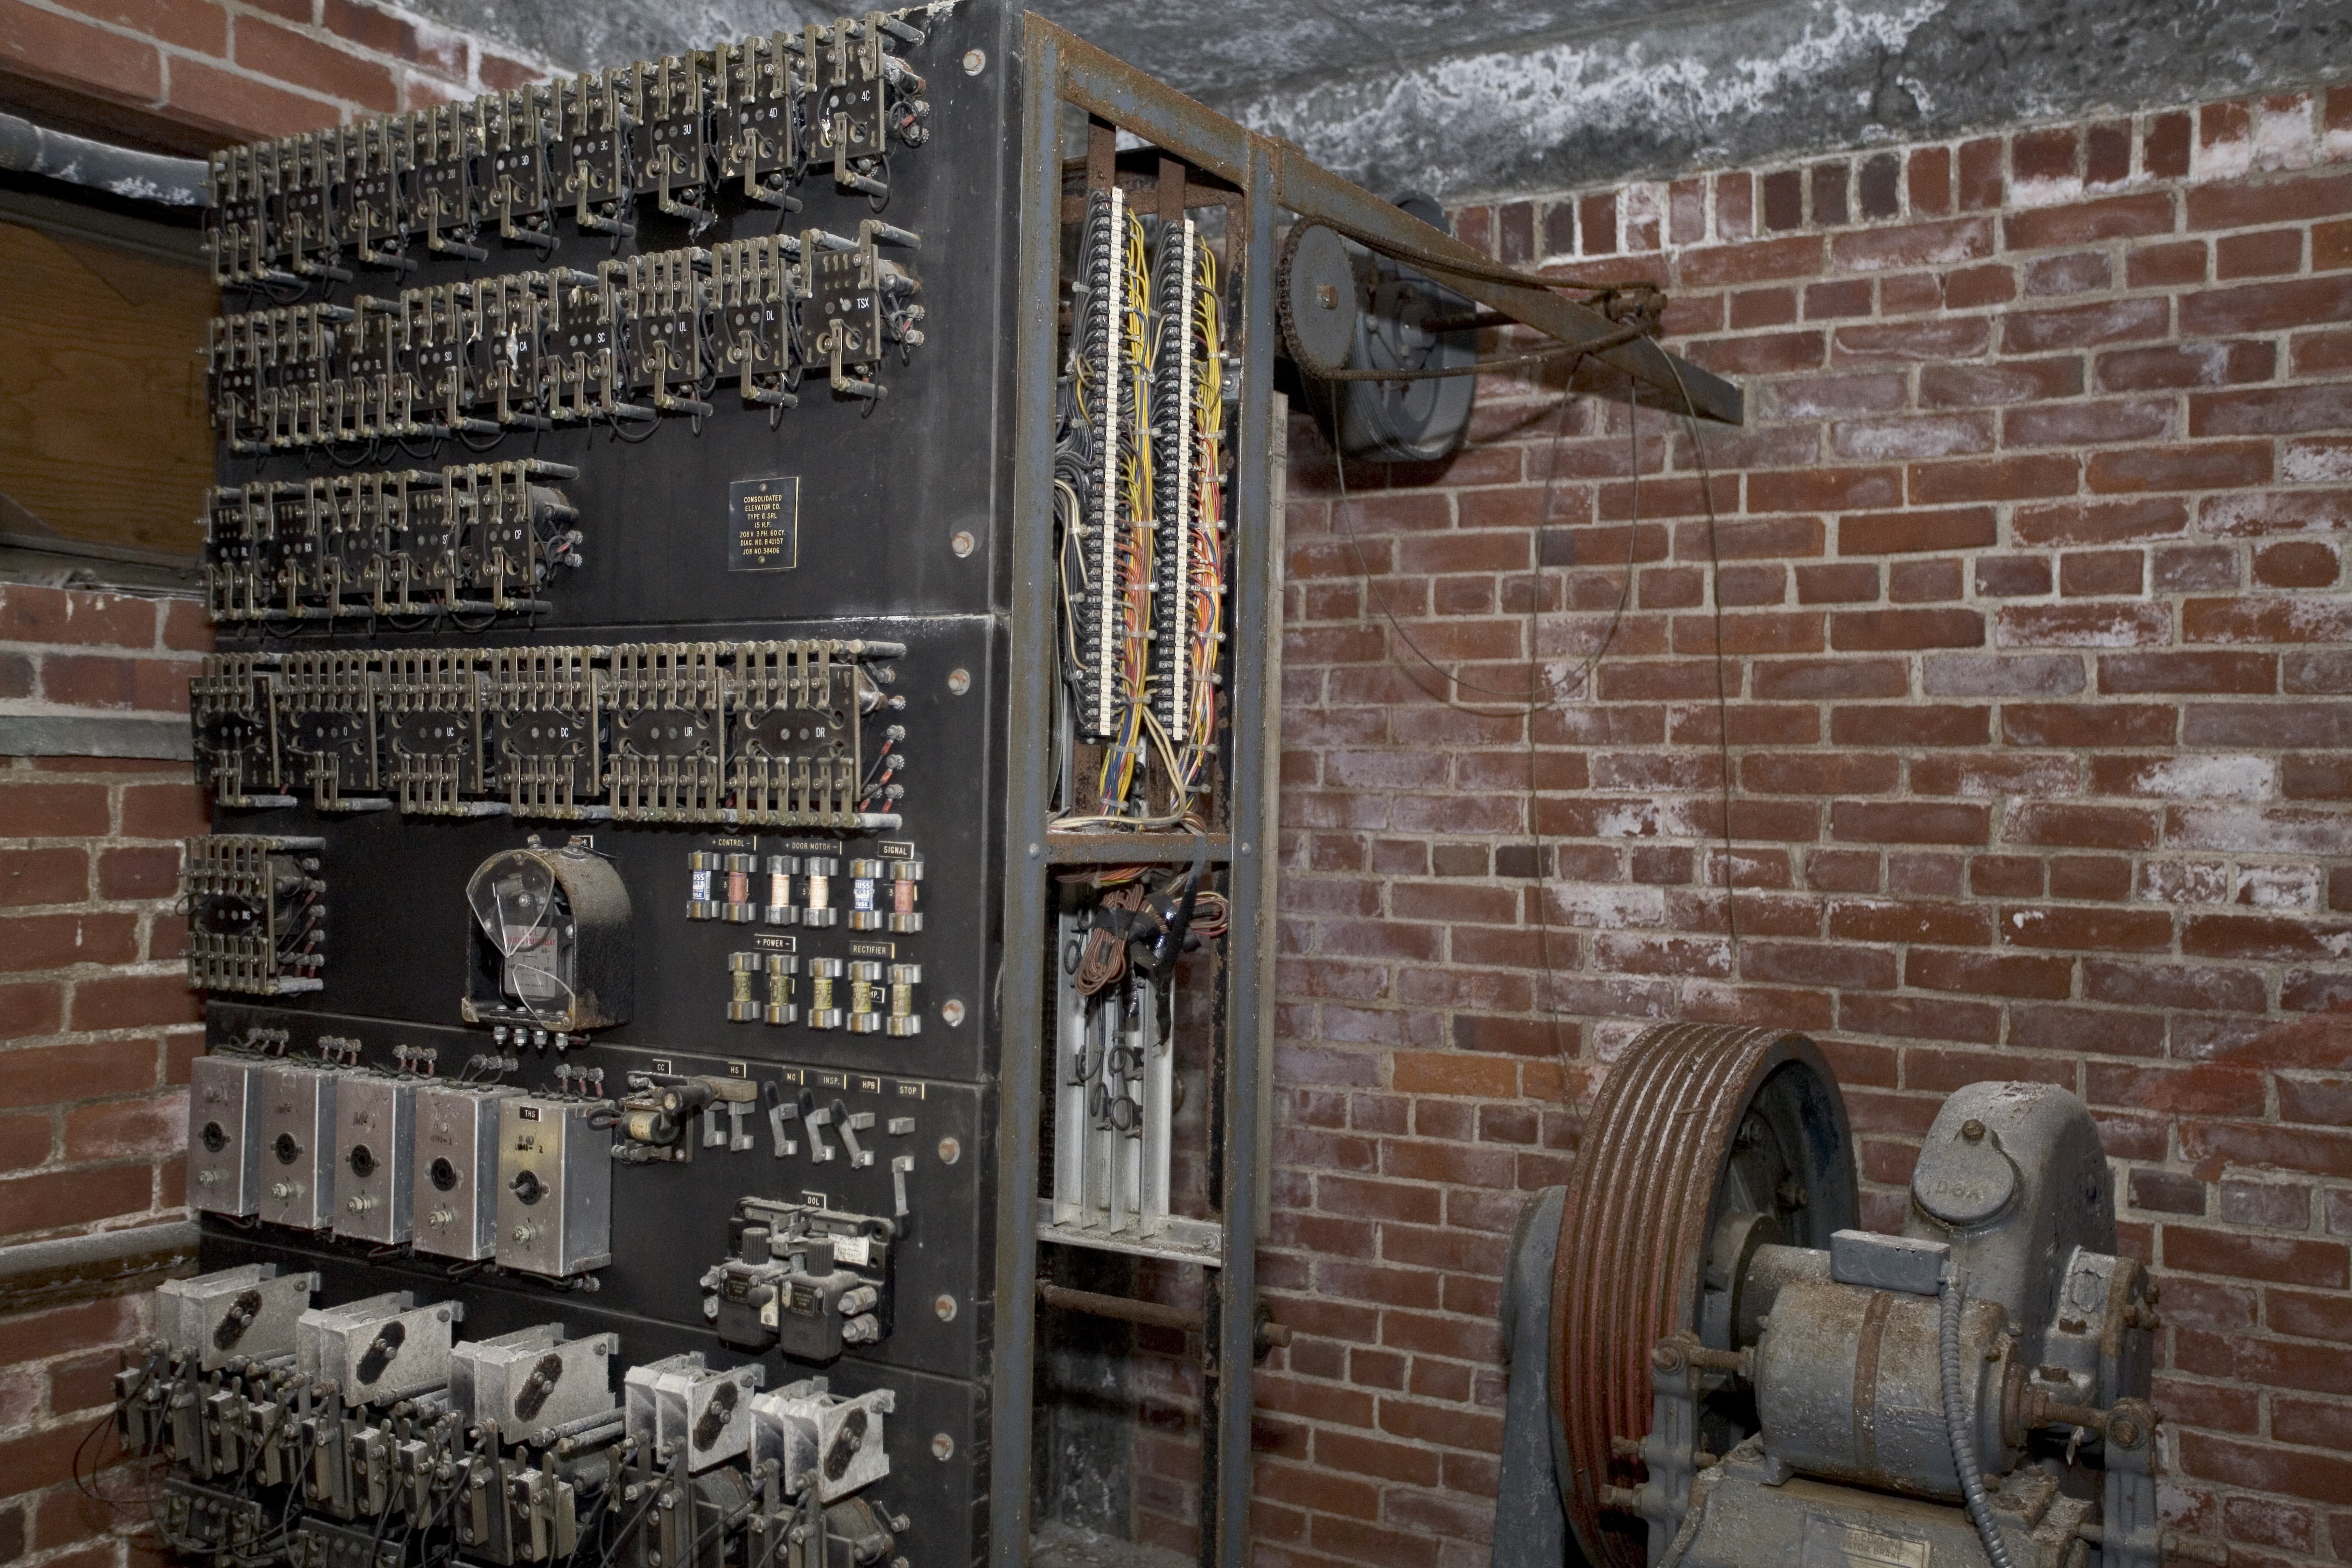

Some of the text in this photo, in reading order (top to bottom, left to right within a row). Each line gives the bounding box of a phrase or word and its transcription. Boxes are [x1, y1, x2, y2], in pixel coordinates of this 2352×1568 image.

[862, 90, 870, 101] 4C
[769, 108, 778, 118] 4D
[683, 124, 691, 135] 3U
[600, 141, 608, 151] 3C
[521, 155, 529, 165] 3D
[448, 169, 456, 179] 2U
[857, 298, 869, 309] TSX
[766, 310, 774, 320] DL
[679, 321, 687, 331] UL
[598, 333, 605, 343] SC
[520, 341, 527, 352] CA
[445, 352, 452, 361] SD
[744, 494, 782, 503] CONSOLIDATED
[515, 529, 521, 539] CP
[446, 727, 454, 737] UC
[561, 727, 569, 737] DC
[684, 727, 692, 737] UR
[816, 727, 825, 737] DR
[884, 845, 907, 855] SIGNAL
[763, 939, 783, 947] POWER
[853, 945, 886, 954] RECTIFIER
[787, 1073, 796, 1081] MG
[823, 1076, 840, 1085] INSP.
[863, 1081, 875, 1089] HPB
[899, 1086, 916, 1094] STOP
[524, 1109, 535, 1118] THS
[808, 1196, 820, 1206] DOL
[1873, 1548, 1902, 1560] BRAKE
